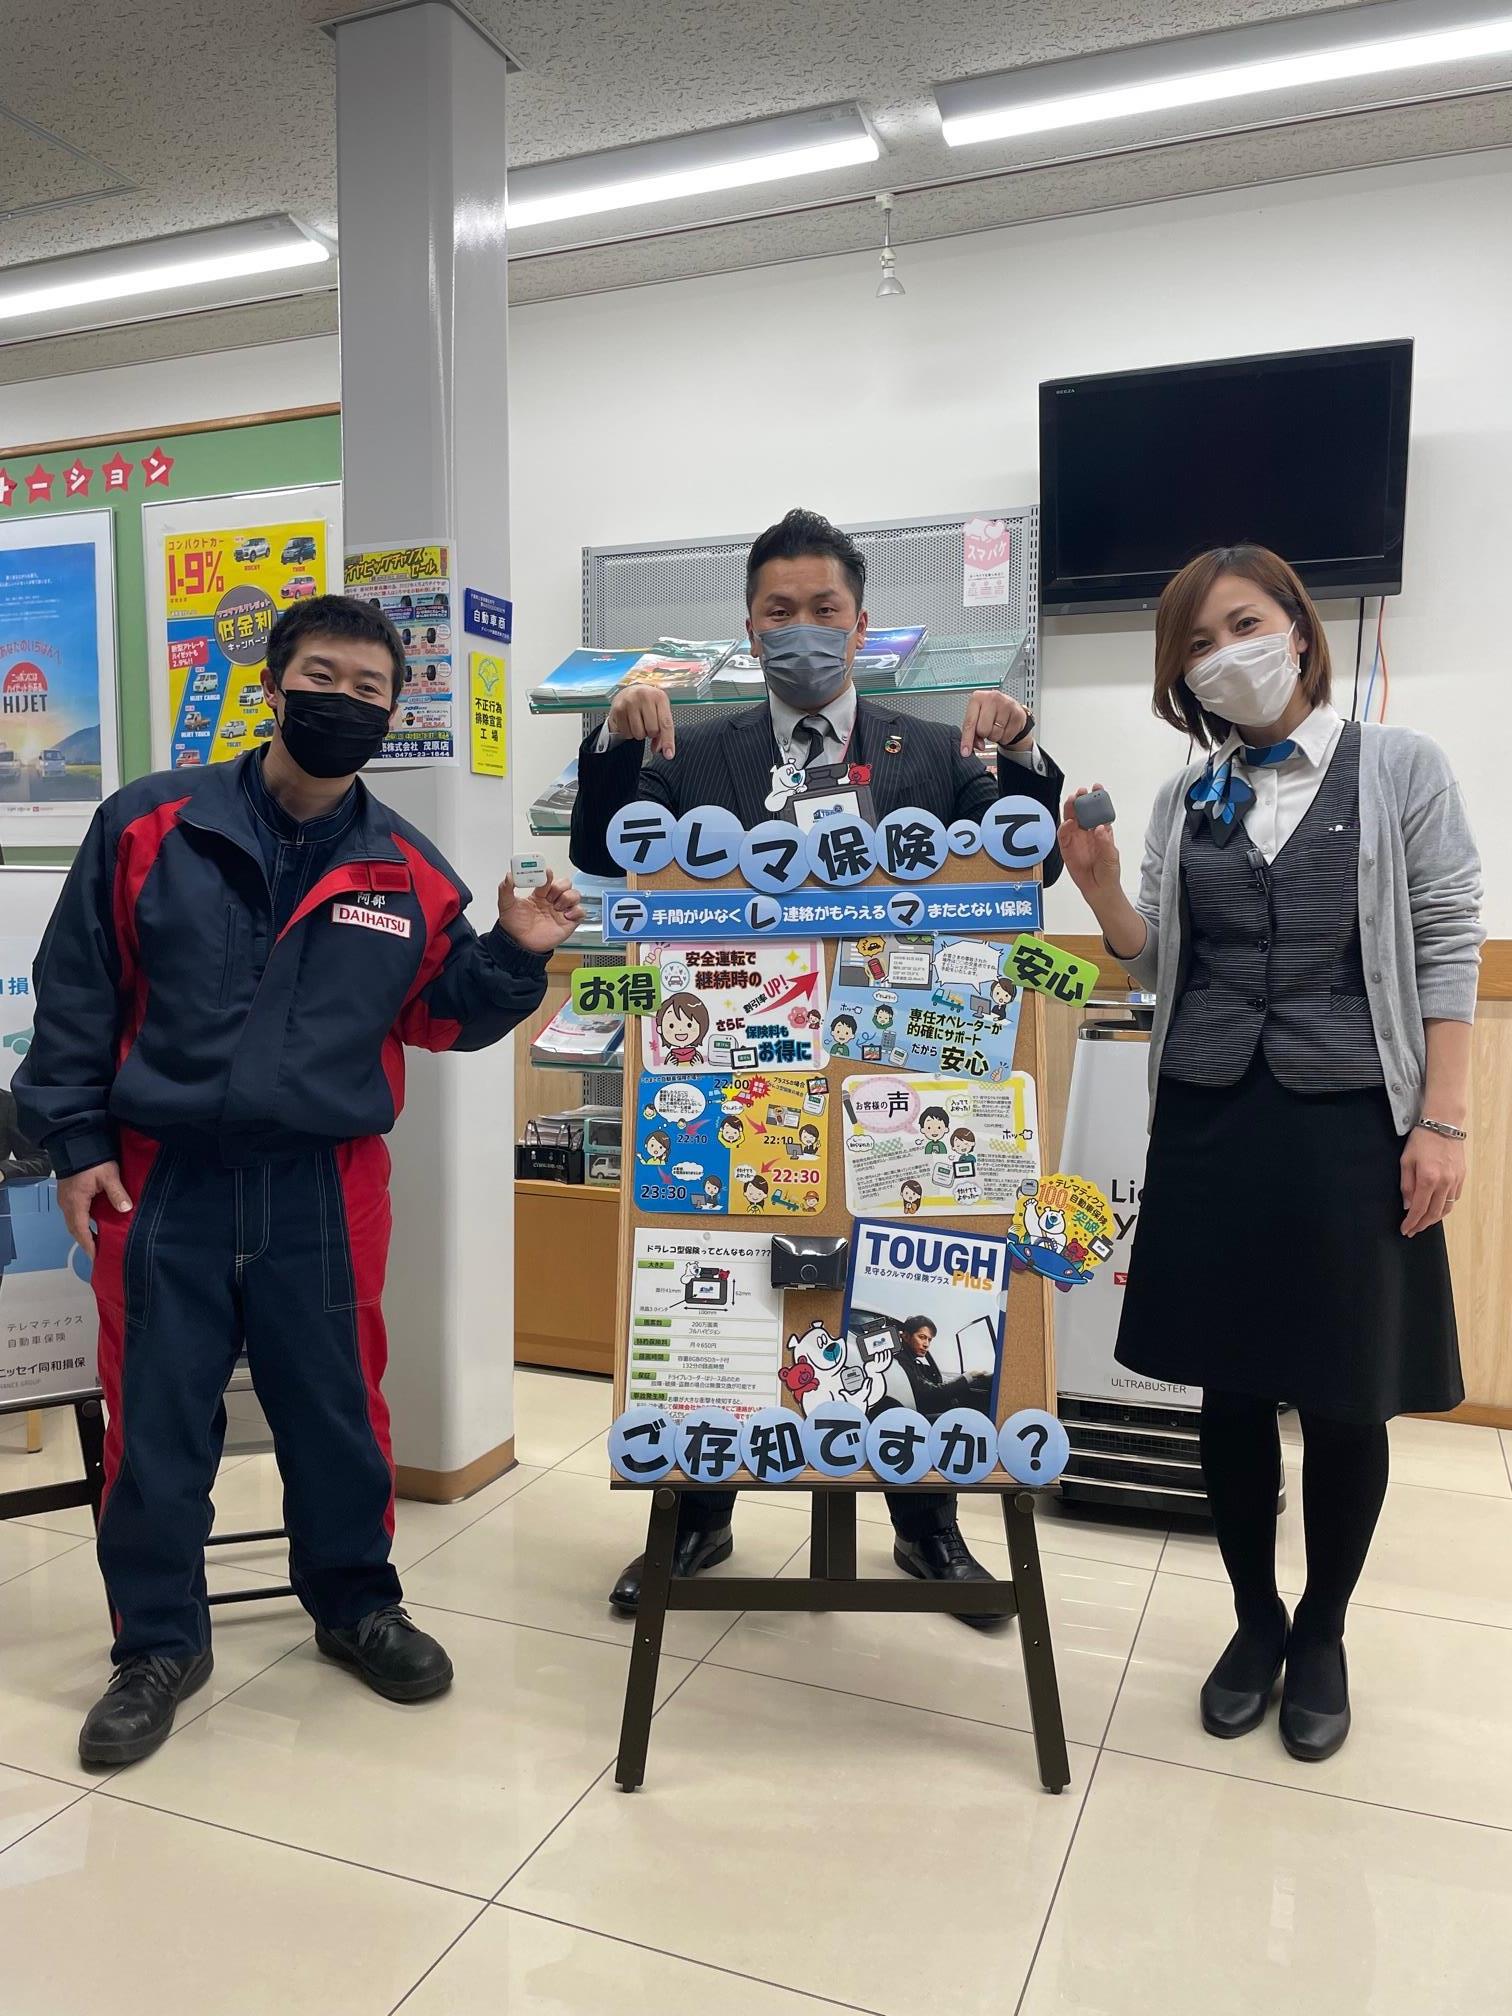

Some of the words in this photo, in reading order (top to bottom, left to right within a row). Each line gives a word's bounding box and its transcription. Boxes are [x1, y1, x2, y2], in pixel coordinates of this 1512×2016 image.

[168, 537, 225, 551] コンパクトカー
[168, 551, 224, 597] 1.9%
[218, 610, 272, 642] 低金利
[473, 609, 506, 630] 自動車商
[228, 636, 268, 652] キャンペーン
[4, 694, 47, 713] HIJET
[475, 697, 503, 714] 不正行為
[475, 712, 503, 729] 排除宣言
[480, 728, 499, 742] 工場
[423, 741, 449, 751] 茂原店
[620, 814, 1040, 883] テレマ保険って
[340, 907, 405, 933] DAIHATSU
[652, 907, 741, 925] 手間が少なく
[783, 905, 886, 923] 連絡がもらえる
[928, 901, 1032, 917] またとない保険
[686, 951, 756, 967] 安全運転で
[695, 970, 762, 989] 継続時の
[1009, 944, 1084, 1002] 安心
[580, 973, 656, 1012] お得
[716, 1018, 746, 1031] さらに
[909, 1008, 1002, 1035] 専任オペレーターが
[745, 1025, 789, 1039] 保険料も
[907, 1022, 981, 1046] 的確にサポート
[758, 1039, 811, 1062] お得に
[912, 1043, 938, 1056] だから
[941, 1047, 989, 1076] 安心
[714, 1079, 749, 1090] 22:00
[856, 1091, 910, 1118] お客様の声
[677, 1135, 707, 1144] 22:10
[764, 1136, 793, 1145] 22:10
[772, 1169, 819, 1184] 22:30
[640, 1186, 686, 1199] 23:30
[1056, 1179, 1105, 1211] テレマティクス
[866, 1232, 998, 1282] TOUGH
[864, 1266, 949, 1286] 見守るクルマの保険プラス
[952, 1271, 993, 1291] Plus
[8, 1315, 84, 1333] テレマティクス
[8, 1332, 66, 1349] 自動車保険
[1111, 1378, 1187, 1394] ULTRABUSTER
